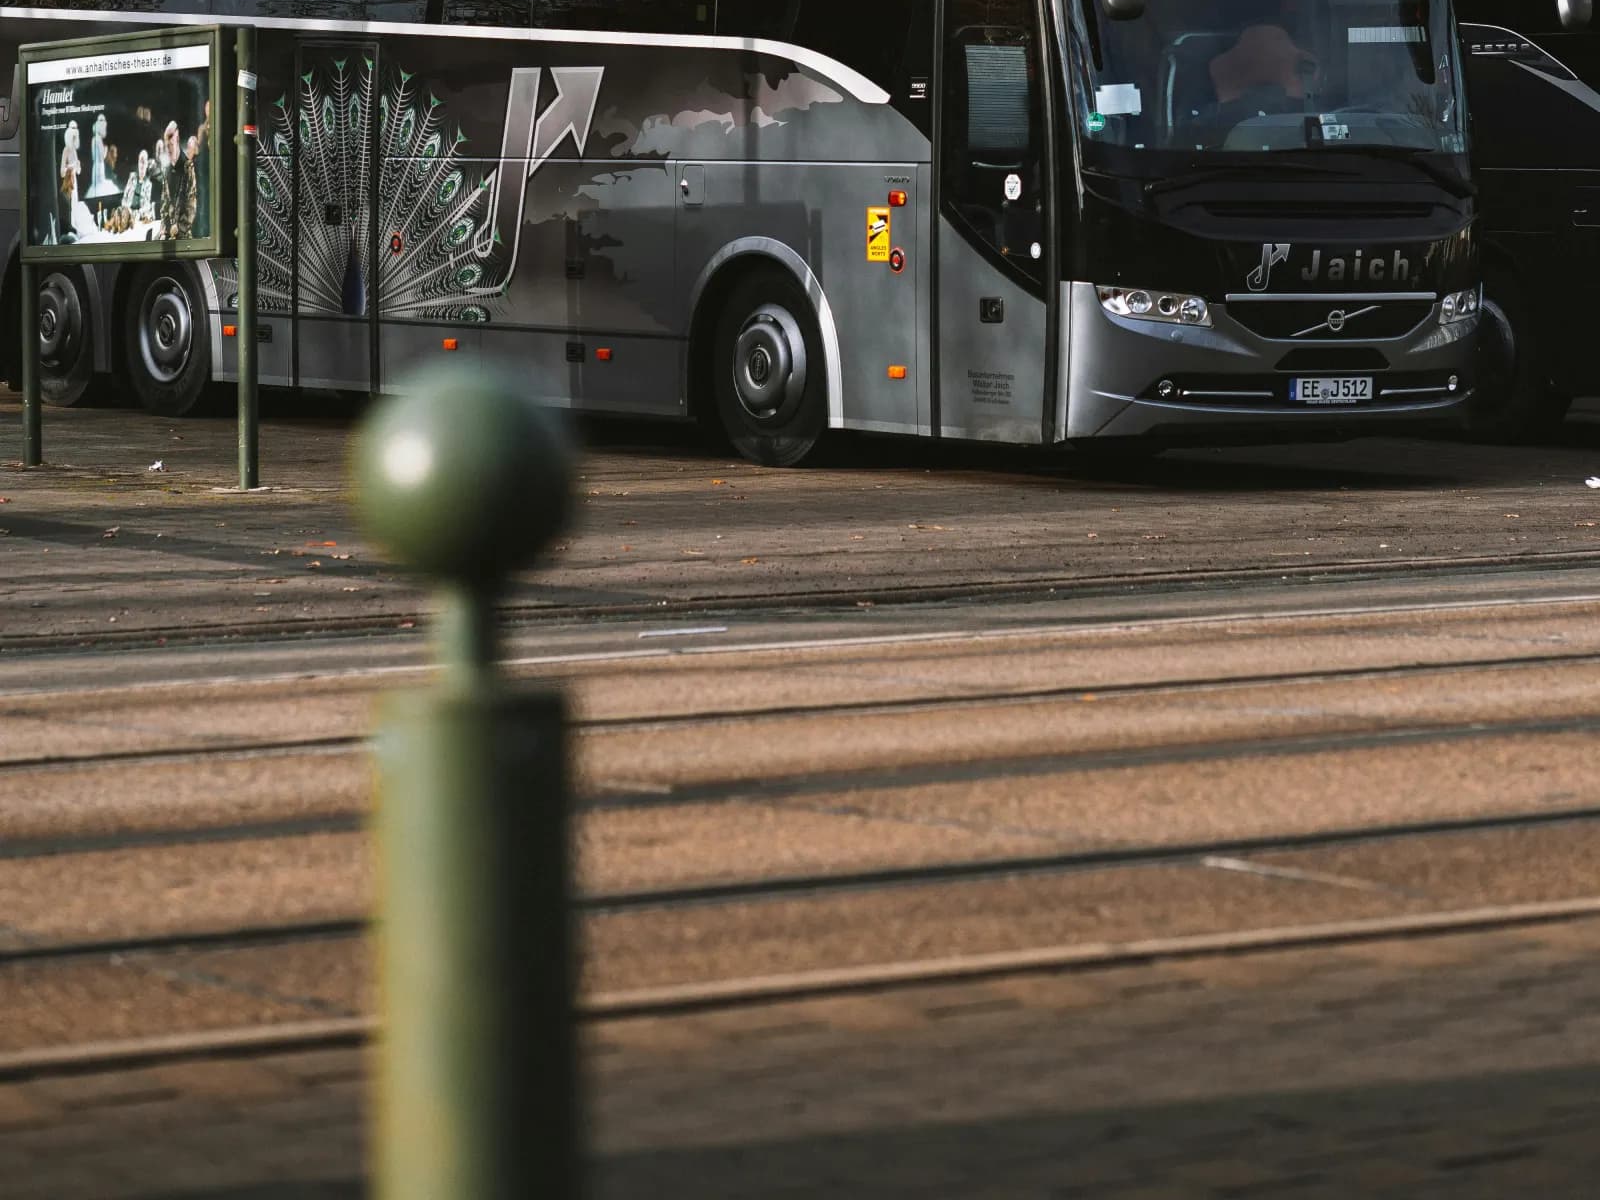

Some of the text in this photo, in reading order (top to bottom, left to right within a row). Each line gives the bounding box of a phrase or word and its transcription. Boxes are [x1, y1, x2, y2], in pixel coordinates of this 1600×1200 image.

[42, 87, 74, 105] Hamlet
[1301, 249, 1409, 281] Jaich
[1302, 380, 1320, 398] EE
